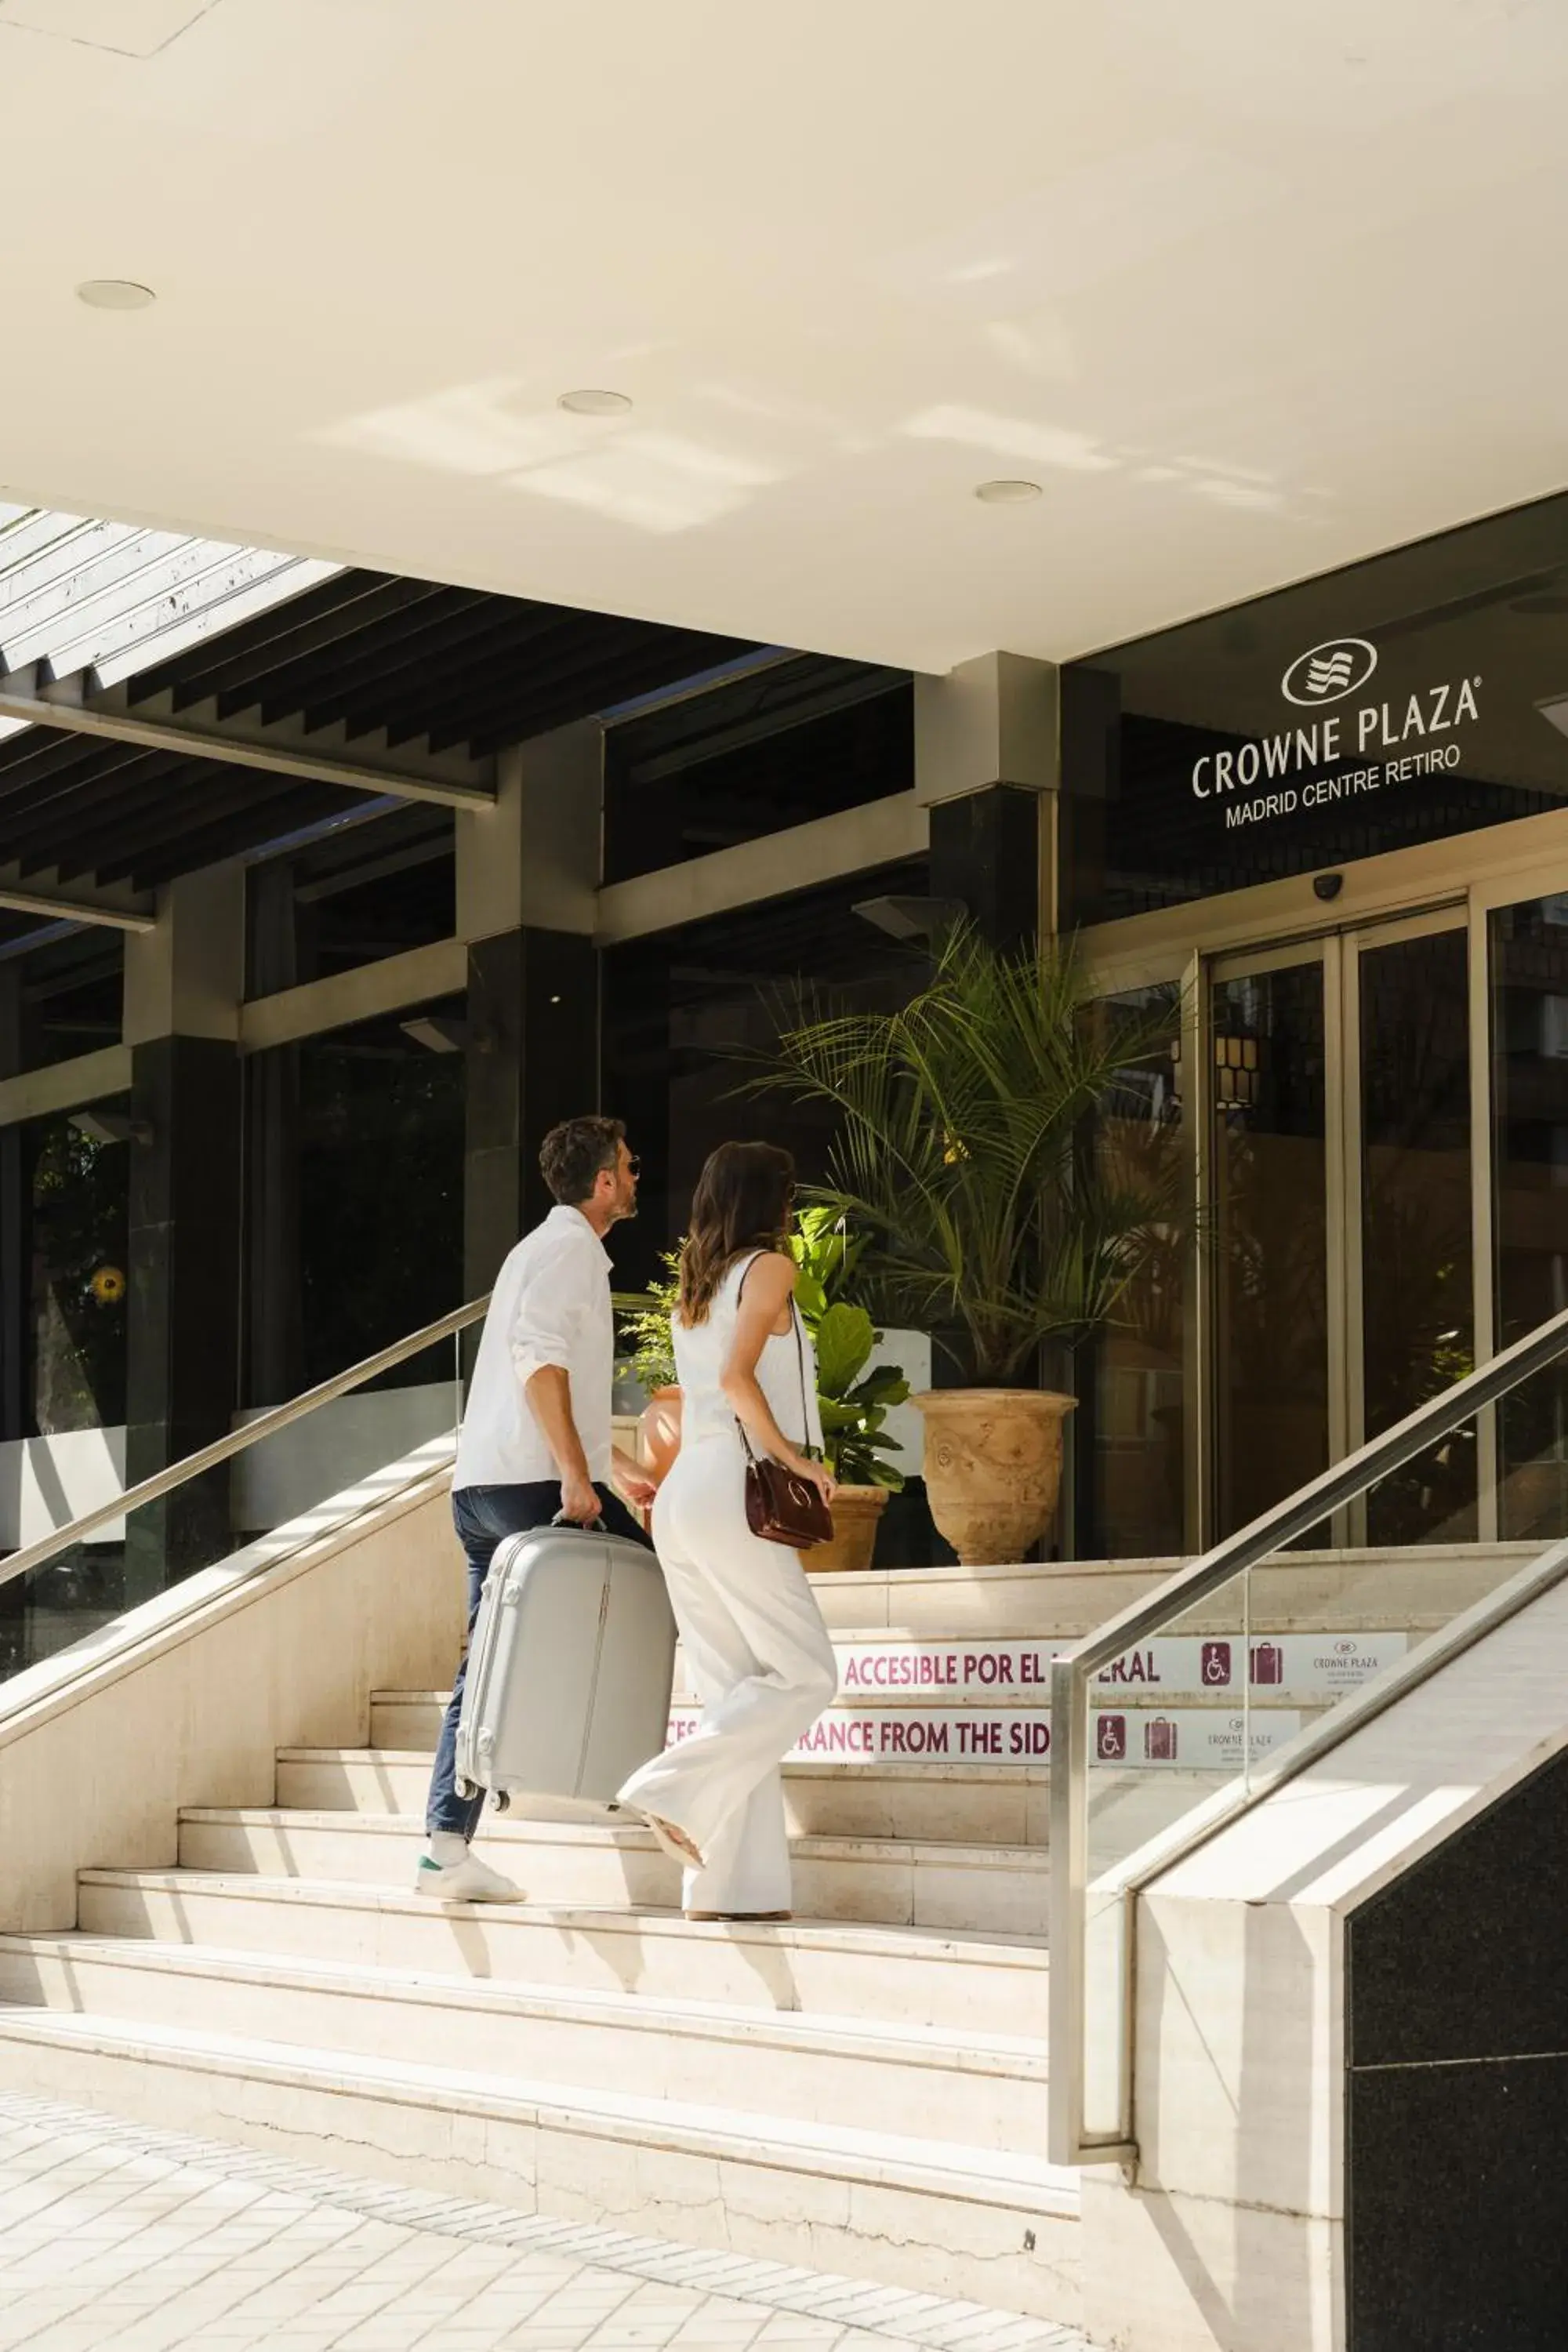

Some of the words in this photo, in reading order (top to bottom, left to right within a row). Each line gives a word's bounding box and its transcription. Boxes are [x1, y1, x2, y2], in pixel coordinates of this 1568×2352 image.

[1192, 717, 1341, 798] CROWNE
[1225, 790, 1298, 829] MADRID
[1302, 766, 1381, 808] CENTRE
[1385, 744, 1461, 785] RETIRO
[844, 1655, 958, 1686] ACCESIBLE
[964, 1653, 1014, 1685] POR
[1020, 1653, 1046, 1683] EL
[1053, 1651, 1161, 1682] ERAL
[798, 1721, 874, 1752] RANCE
[880, 1721, 949, 1753] FROM
[955, 1722, 1003, 1753] THE
[1010, 1722, 1051, 1754] SID
